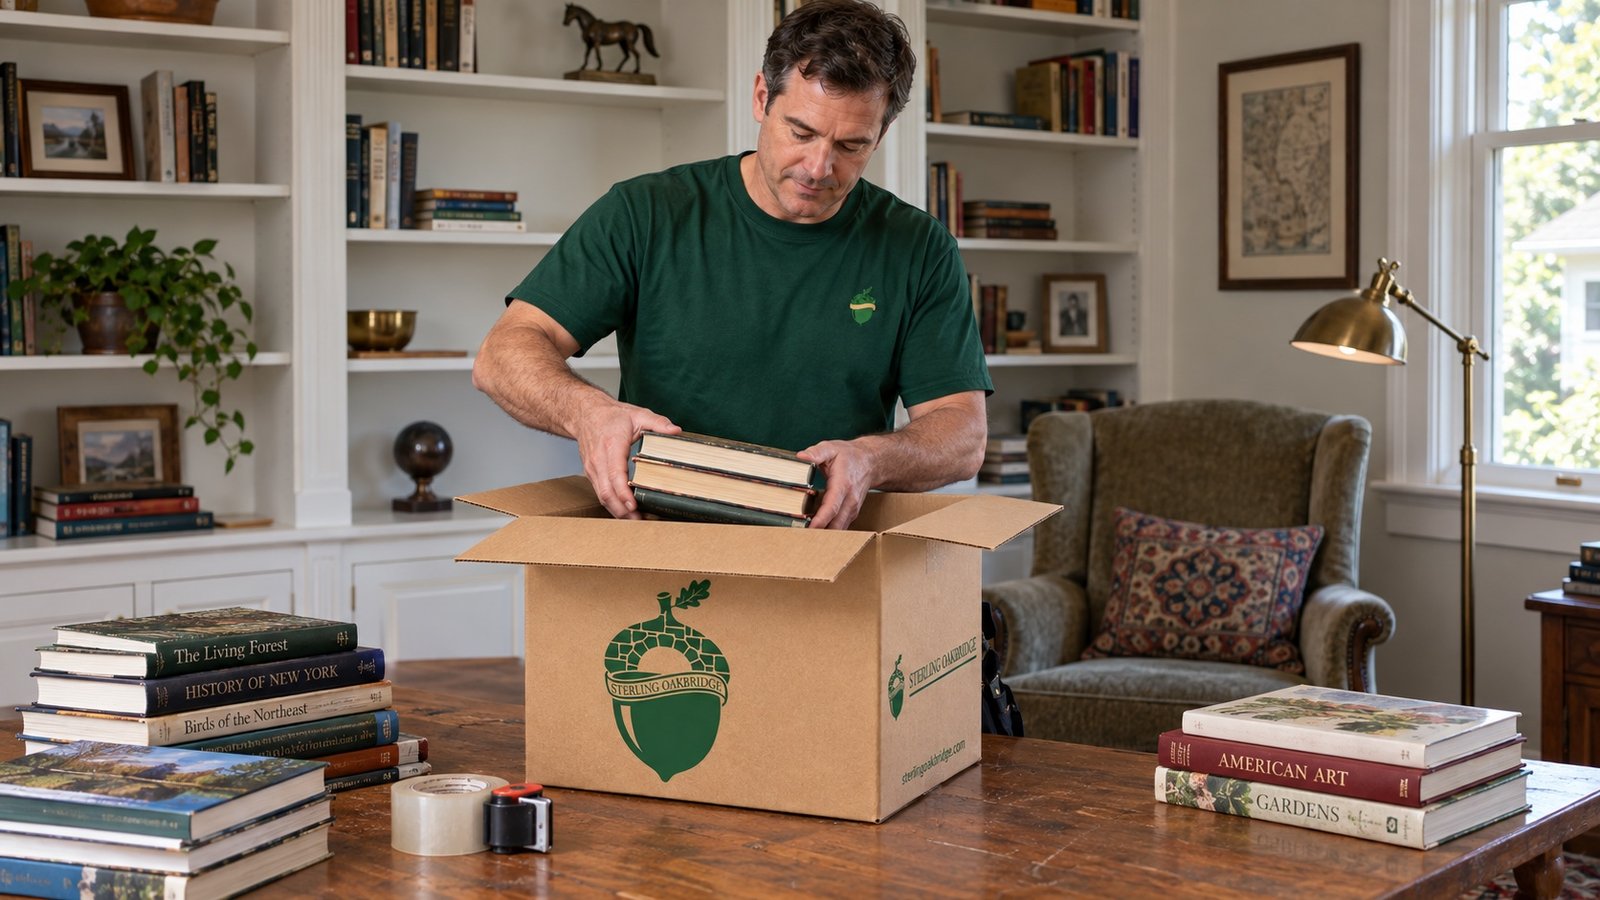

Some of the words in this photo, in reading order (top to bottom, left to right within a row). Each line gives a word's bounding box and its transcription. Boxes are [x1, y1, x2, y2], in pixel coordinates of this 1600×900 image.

[174, 648, 200, 665] The
[203, 643, 246, 662] Living
[249, 639, 288, 655] Forest
[908, 657, 941, 689] STERLING
[941, 636, 977, 669] OAKBRIDGE
[185, 678, 245, 700] HISTORY
[248, 675, 265, 690] OF
[269, 669, 301, 688] NEW
[304, 664, 339, 682] YORK
[611, 681, 660, 696] STERLING
[661, 676, 722, 692] OAKBRIDGE
[184, 718, 215, 736] Birds
[217, 713, 232, 727] of
[233, 710, 251, 726] the
[253, 703, 308, 723] Northeast
[901, 739, 966, 785] sterlingoakbridge.com
[1218, 752, 1308, 781] AMERICAN
[1313, 767, 1349, 787] ART
[1256, 793, 1340, 823] GARDENS
